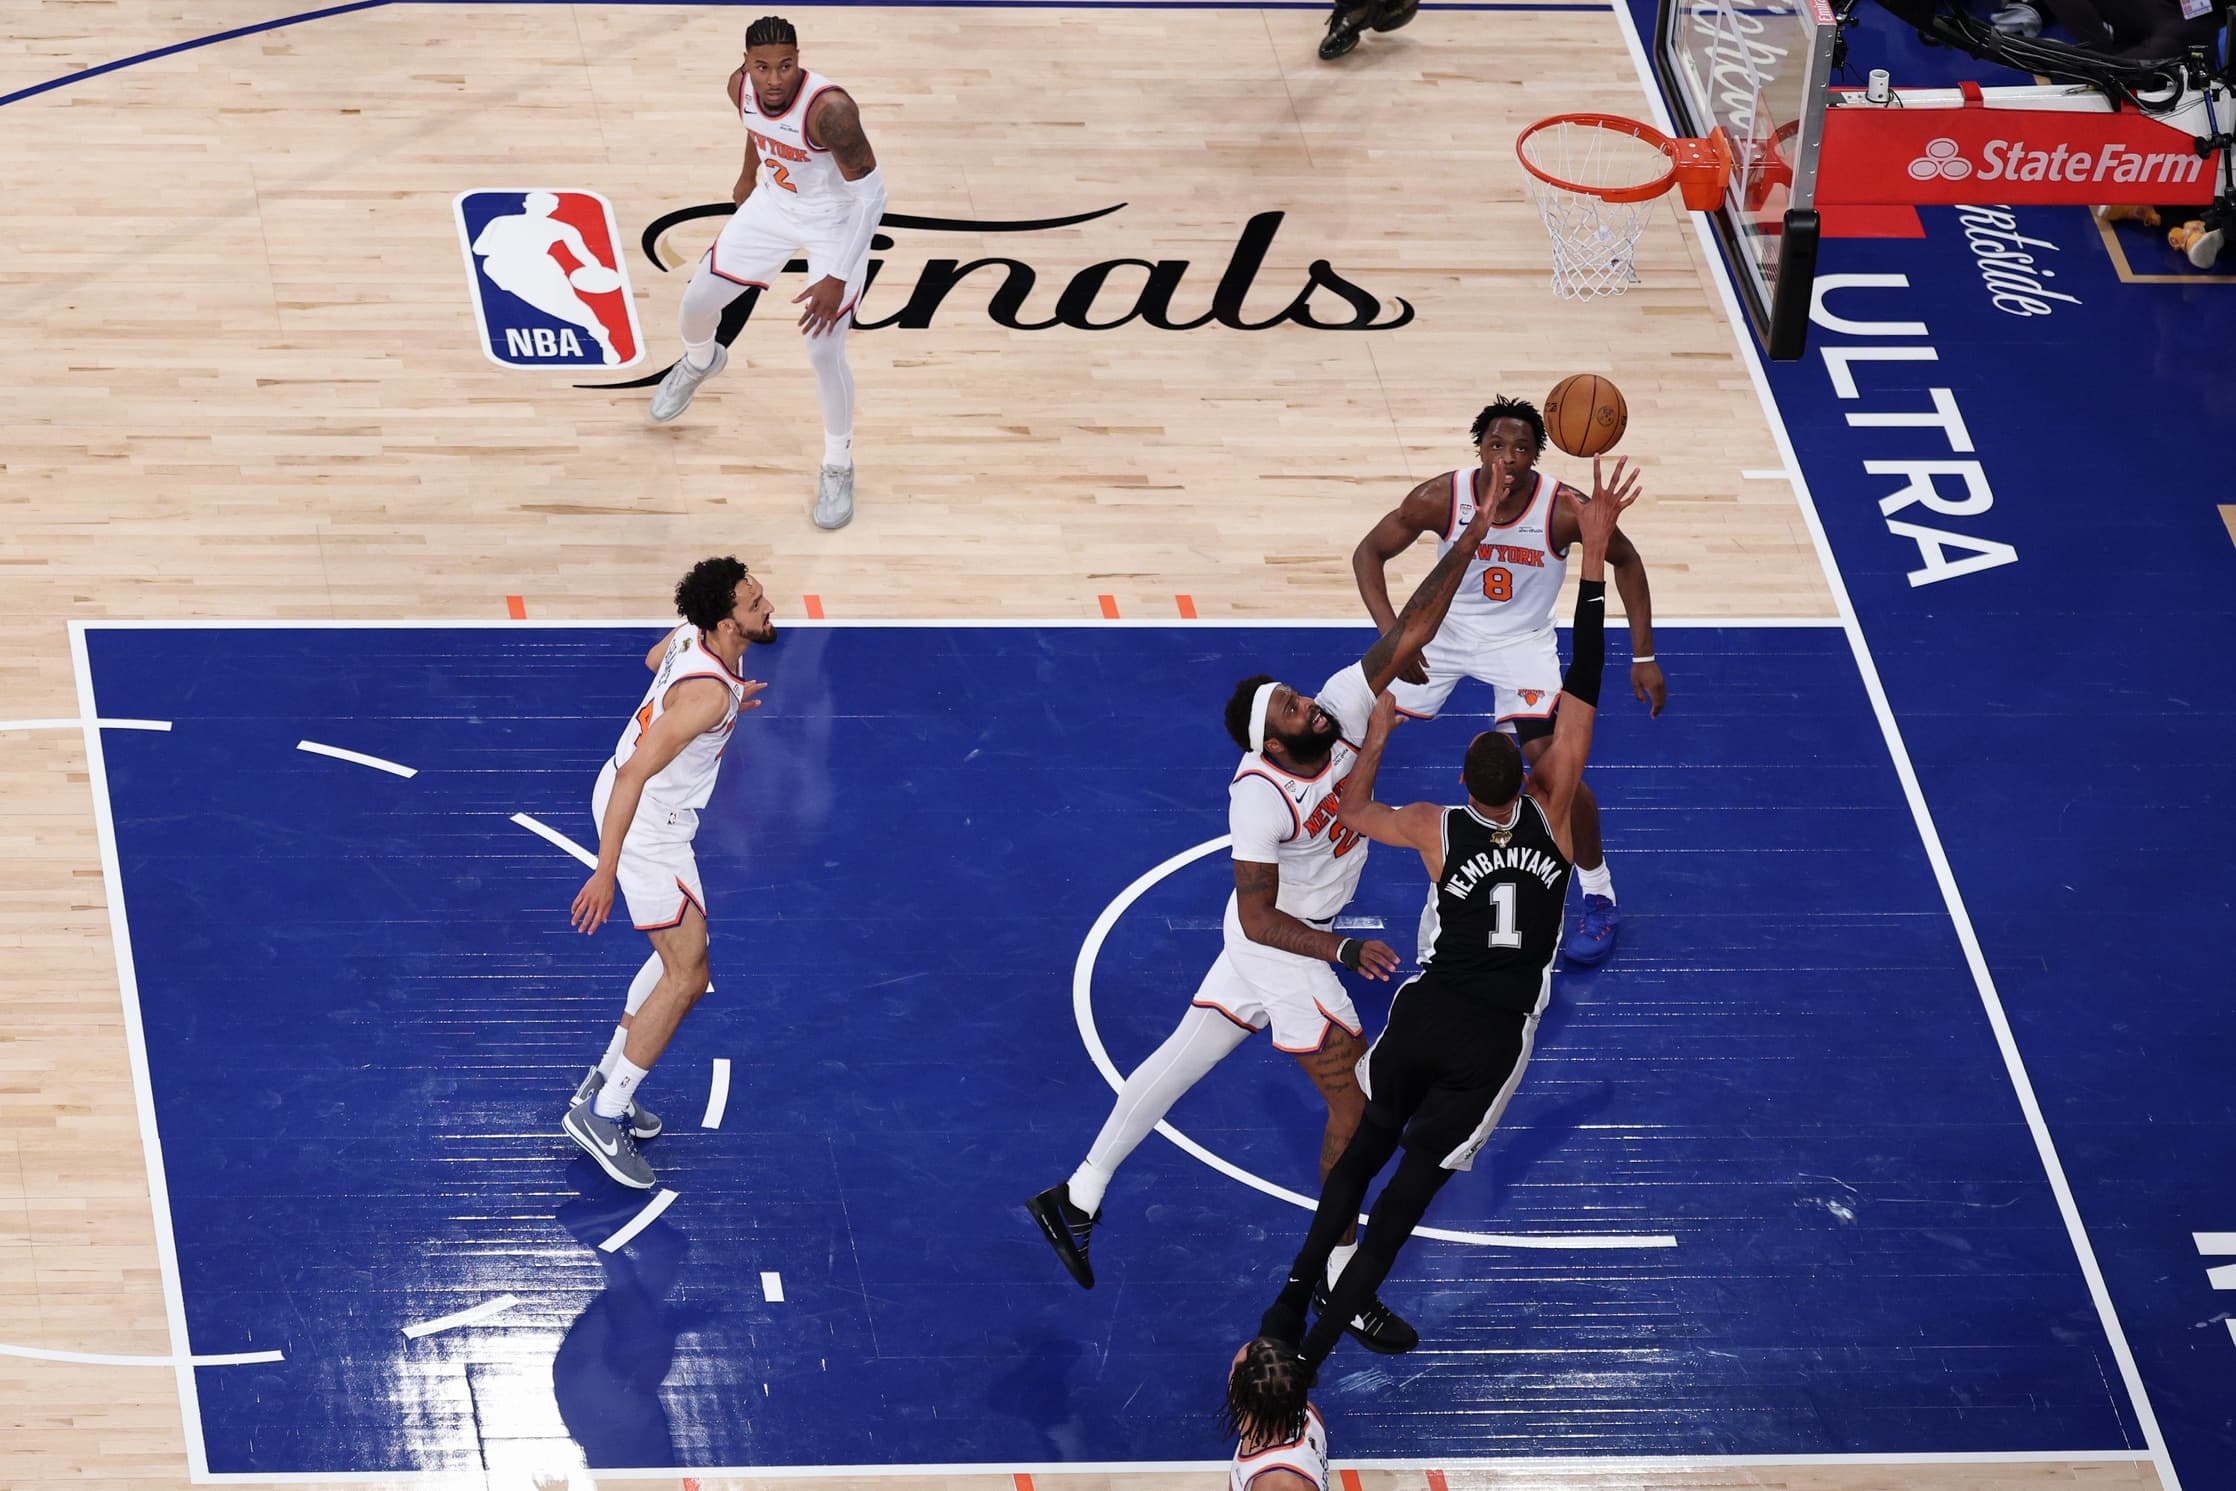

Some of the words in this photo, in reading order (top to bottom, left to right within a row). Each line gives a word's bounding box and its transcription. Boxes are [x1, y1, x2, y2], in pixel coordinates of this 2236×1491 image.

[764, 158, 798, 193] 2
[505, 328, 585, 357] NBA
[1809, 273, 2019, 588] ULTRA
[1496, 544, 1545, 568] YORK
[1483, 566, 1513, 602] 8
[1303, 792, 1340, 840] NEW
[1328, 820, 1362, 859] 2
[1444, 847, 1562, 900] WEMBANYAMA
[1488, 882, 1522, 949] 1
